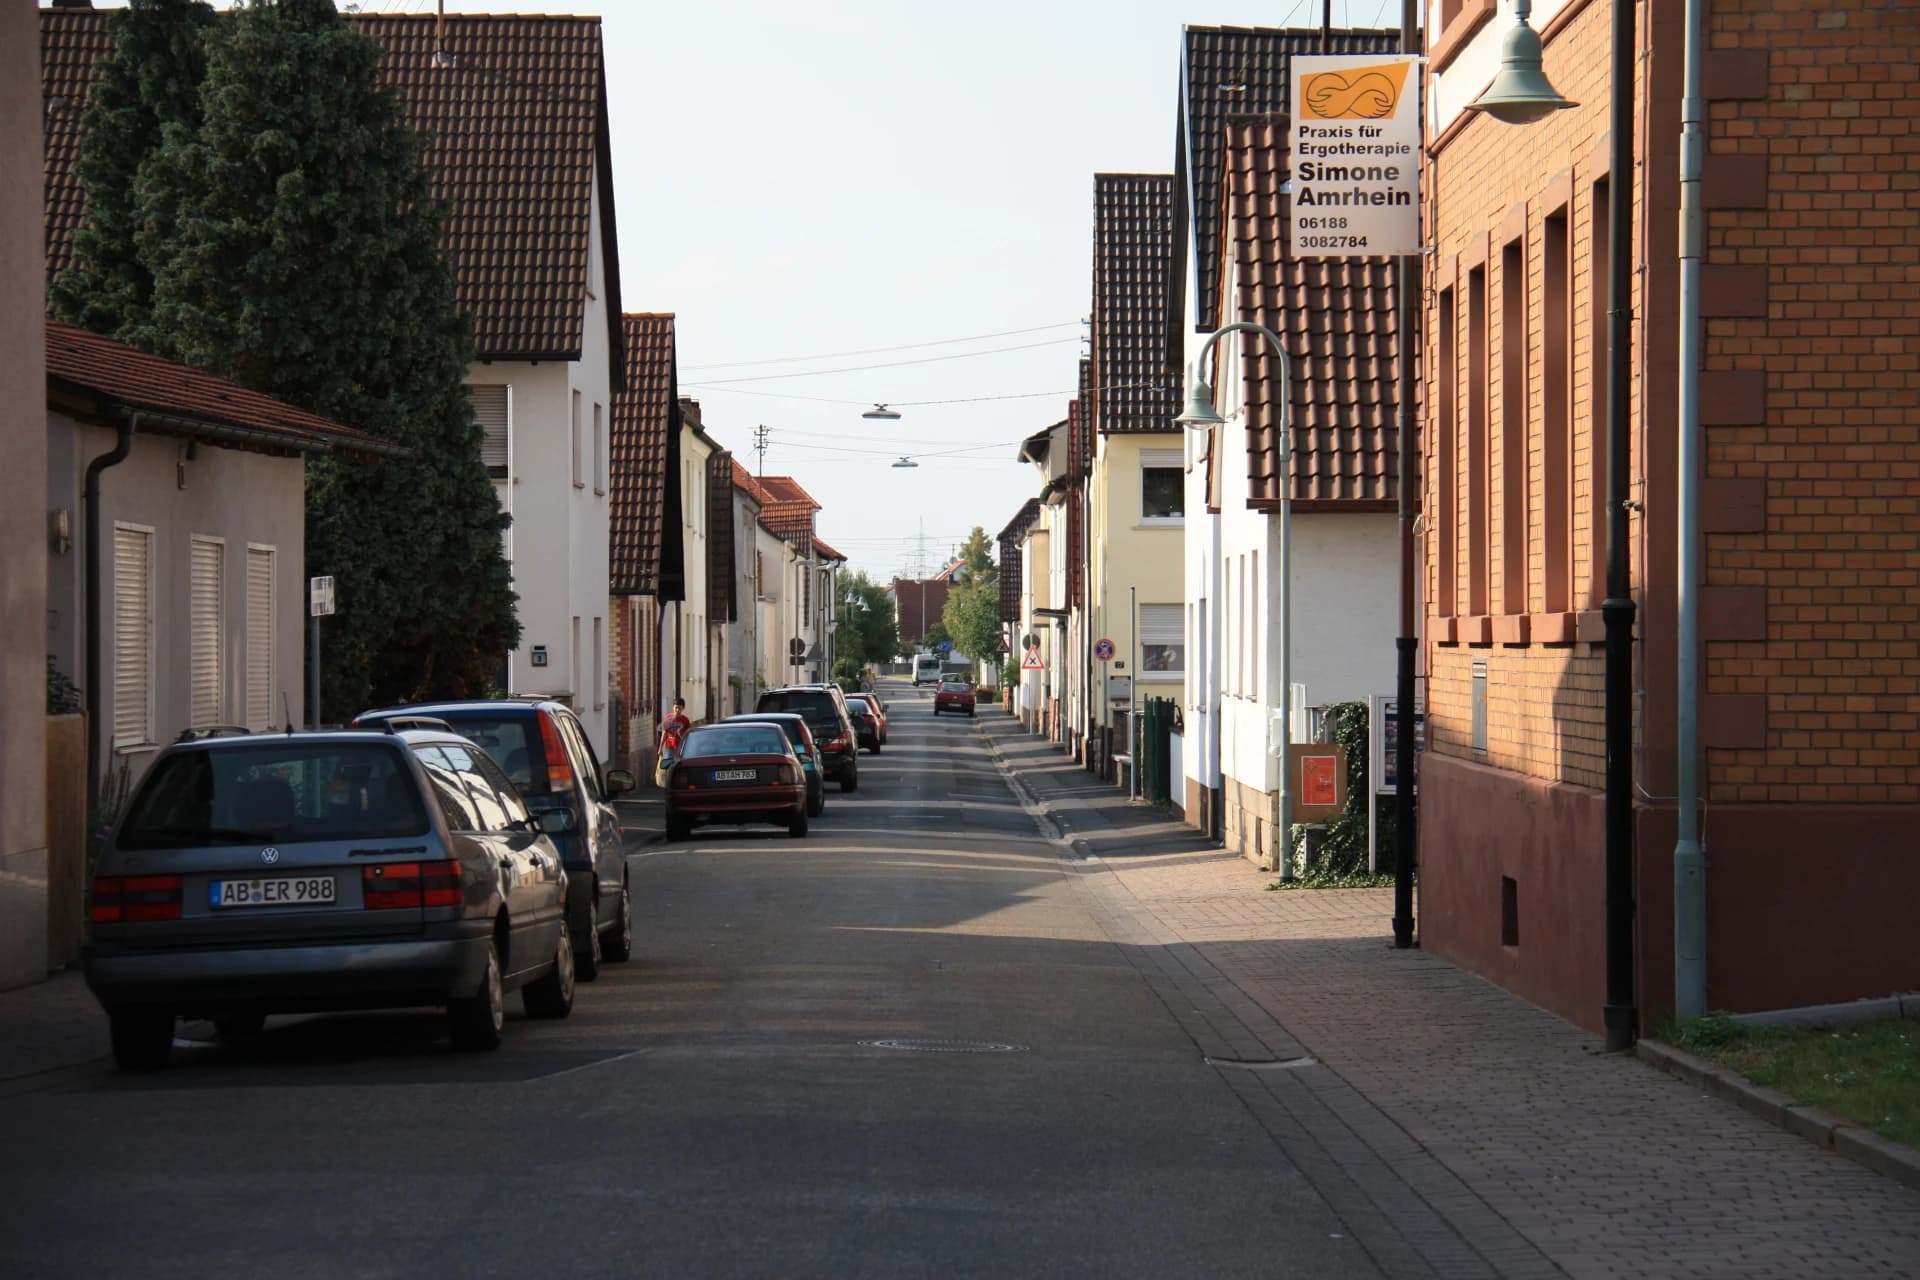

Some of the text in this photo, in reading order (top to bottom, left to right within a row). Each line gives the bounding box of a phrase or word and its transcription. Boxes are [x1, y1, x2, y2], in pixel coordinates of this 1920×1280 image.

[1299, 126, 1383, 138] Praxis für
[1299, 142, 1411, 157] Ergotherapie
[1299, 162, 1400, 181] Simone
[1297, 186, 1411, 206] Amrhein
[1299, 217, 1348, 229] 06188
[1299, 236, 1368, 248] 3082784
[223, 879, 333, 902] AB ER 988
